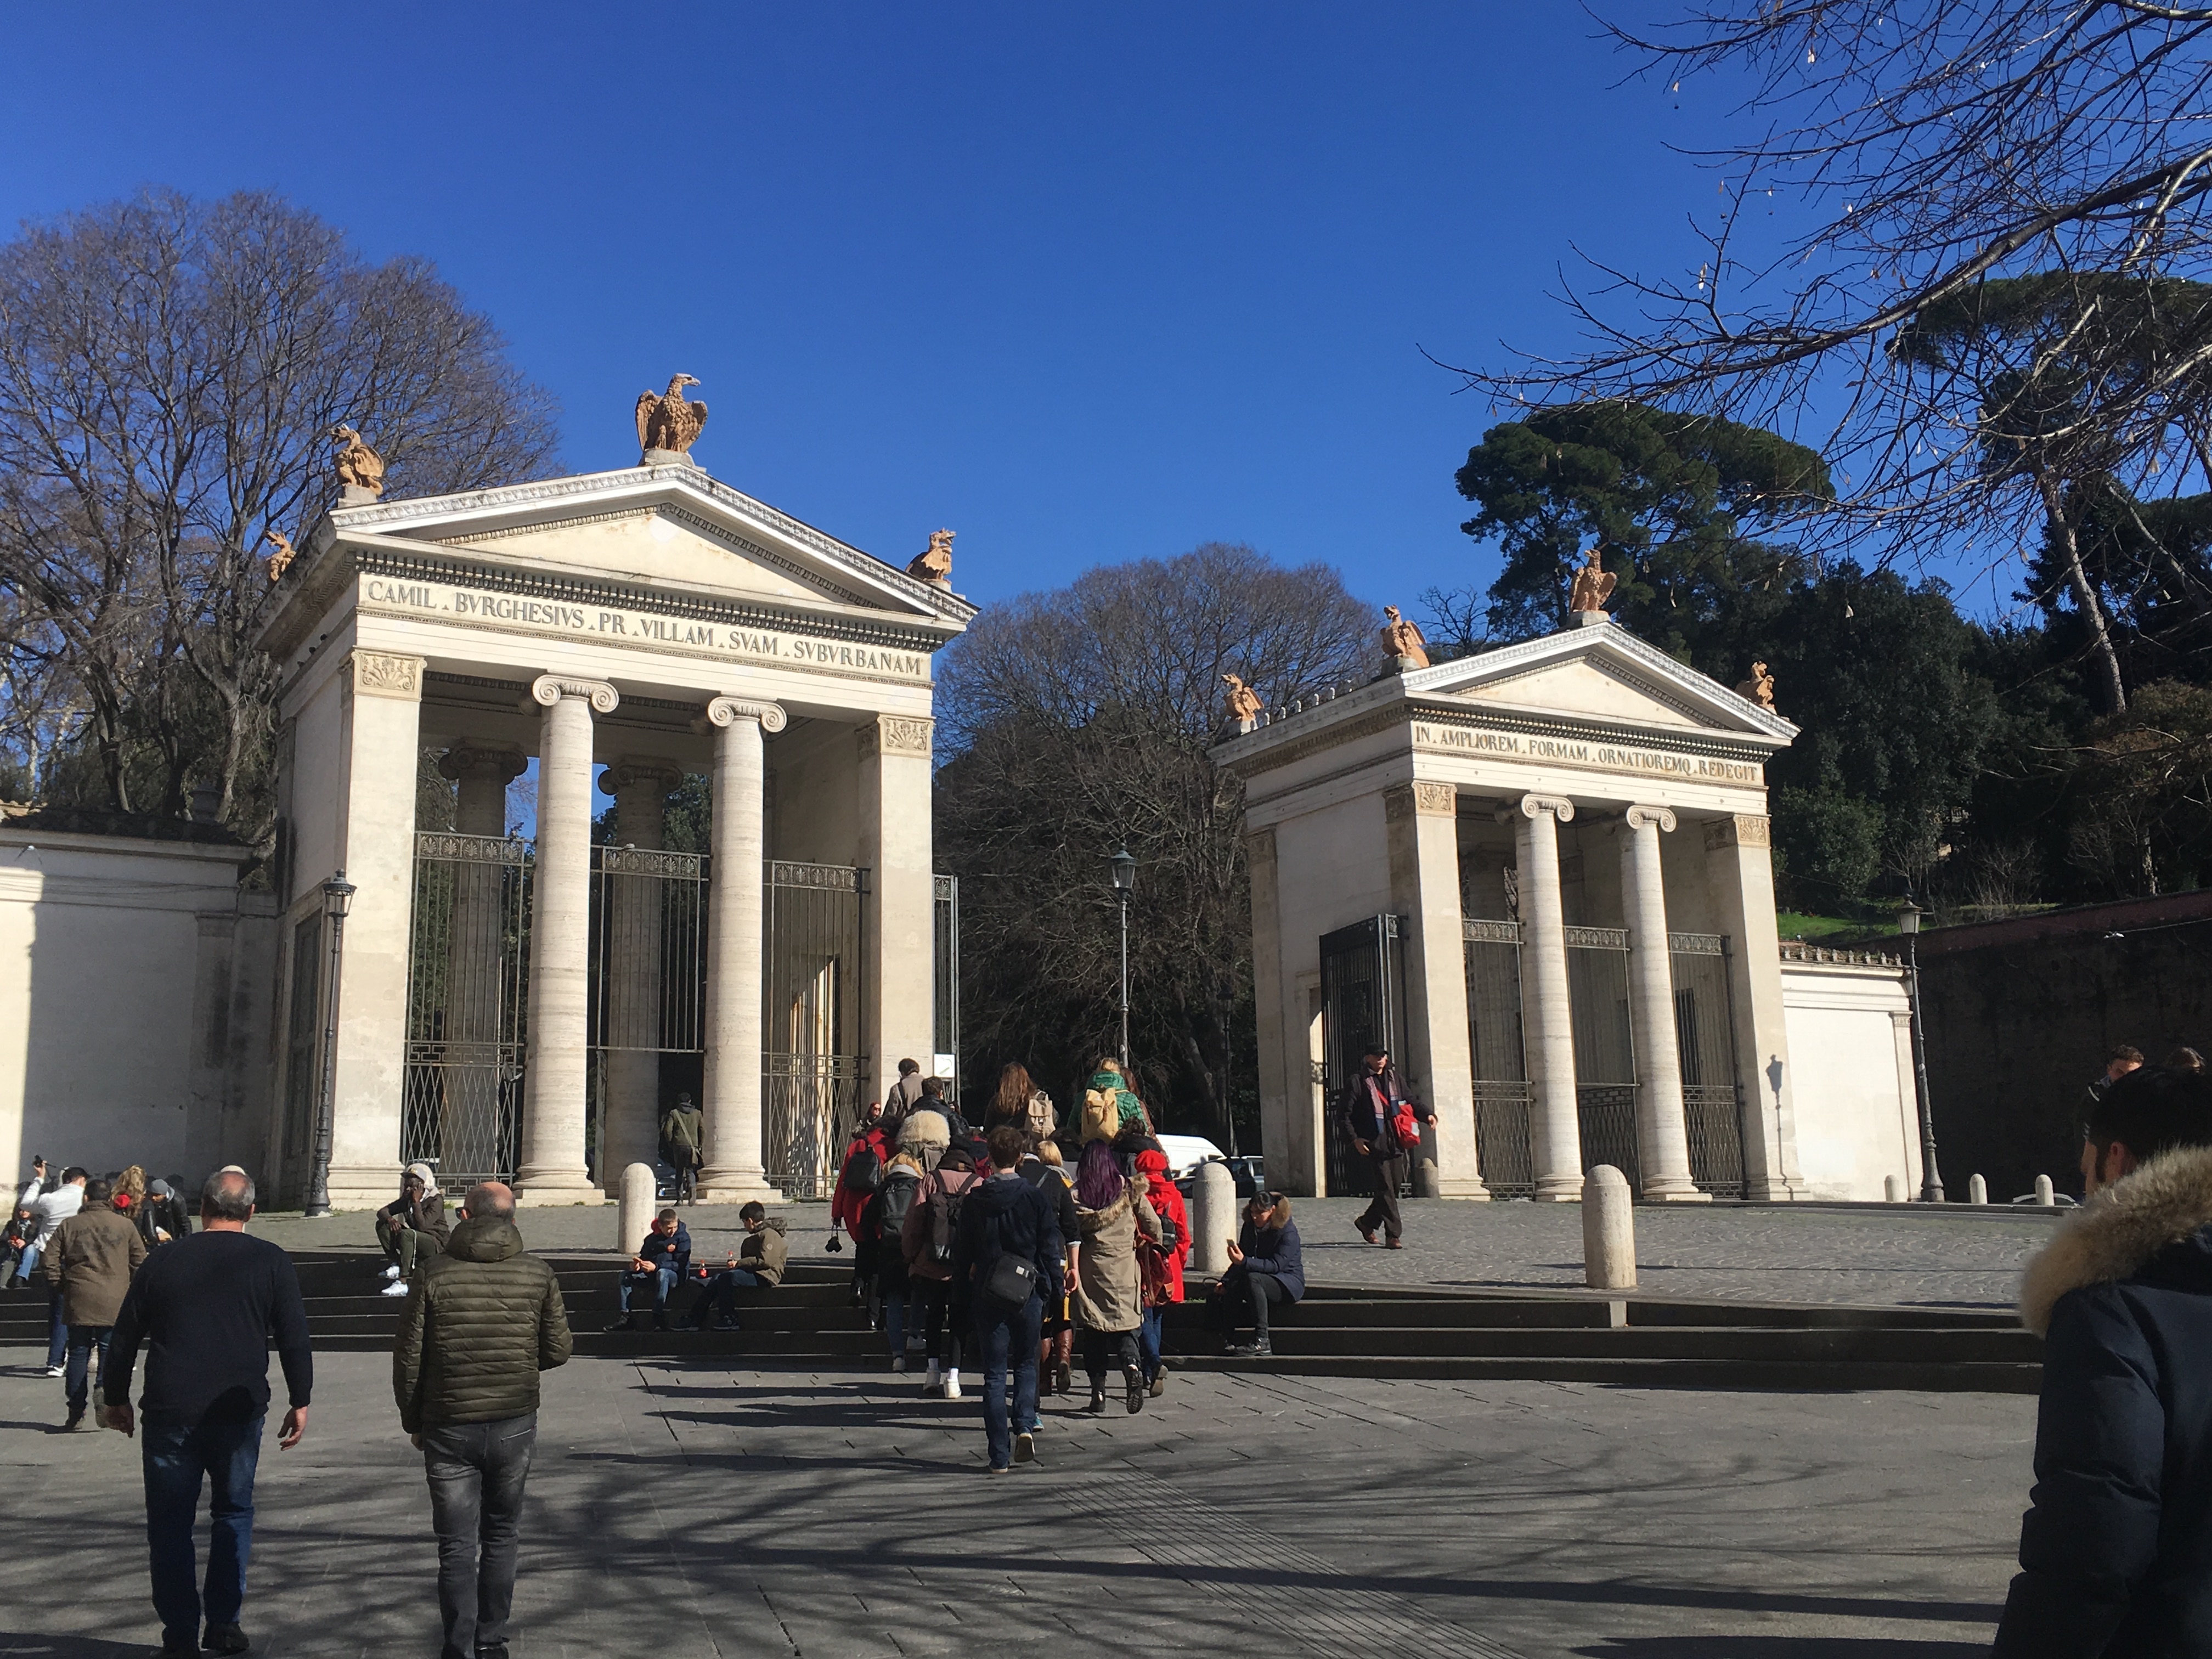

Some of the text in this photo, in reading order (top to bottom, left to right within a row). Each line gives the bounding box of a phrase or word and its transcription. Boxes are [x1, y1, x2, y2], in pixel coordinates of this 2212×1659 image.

[368, 580, 921, 675] CAMIL BVRGHESIVS PR VILLAM SVAM SVBVRBANAM
[1415, 725, 1430, 742] IN
[1441, 729, 1519, 753] AMPLIOREM
[1529, 740, 1588, 761] FORMAM
[1699, 760, 1758, 781] REDEGIT
